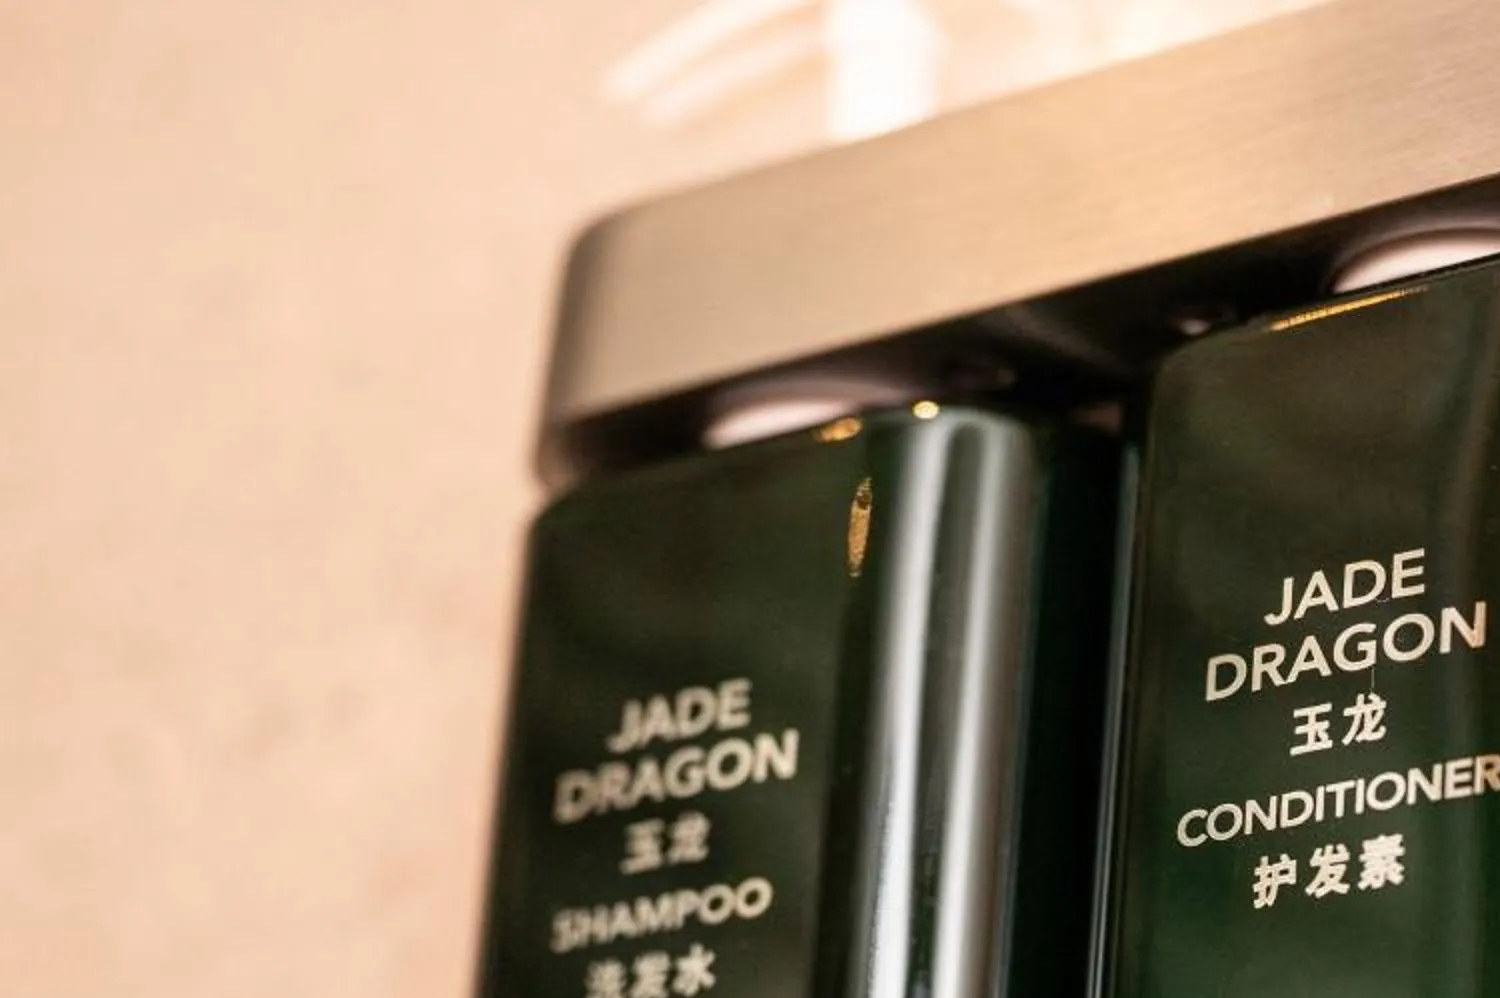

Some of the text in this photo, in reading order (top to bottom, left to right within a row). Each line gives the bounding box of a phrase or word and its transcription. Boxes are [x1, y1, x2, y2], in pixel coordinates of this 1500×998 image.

[1264, 548, 1426, 626] JADE
[1206, 602, 1487, 701] DRAGON
[606, 677, 752, 753] JADE
[1289, 692, 1388, 756] 玉龙
[553, 728, 799, 824] DRAGON
[1252, 833, 1406, 909] 护发素
[549, 877, 774, 954] SHAMPOO
